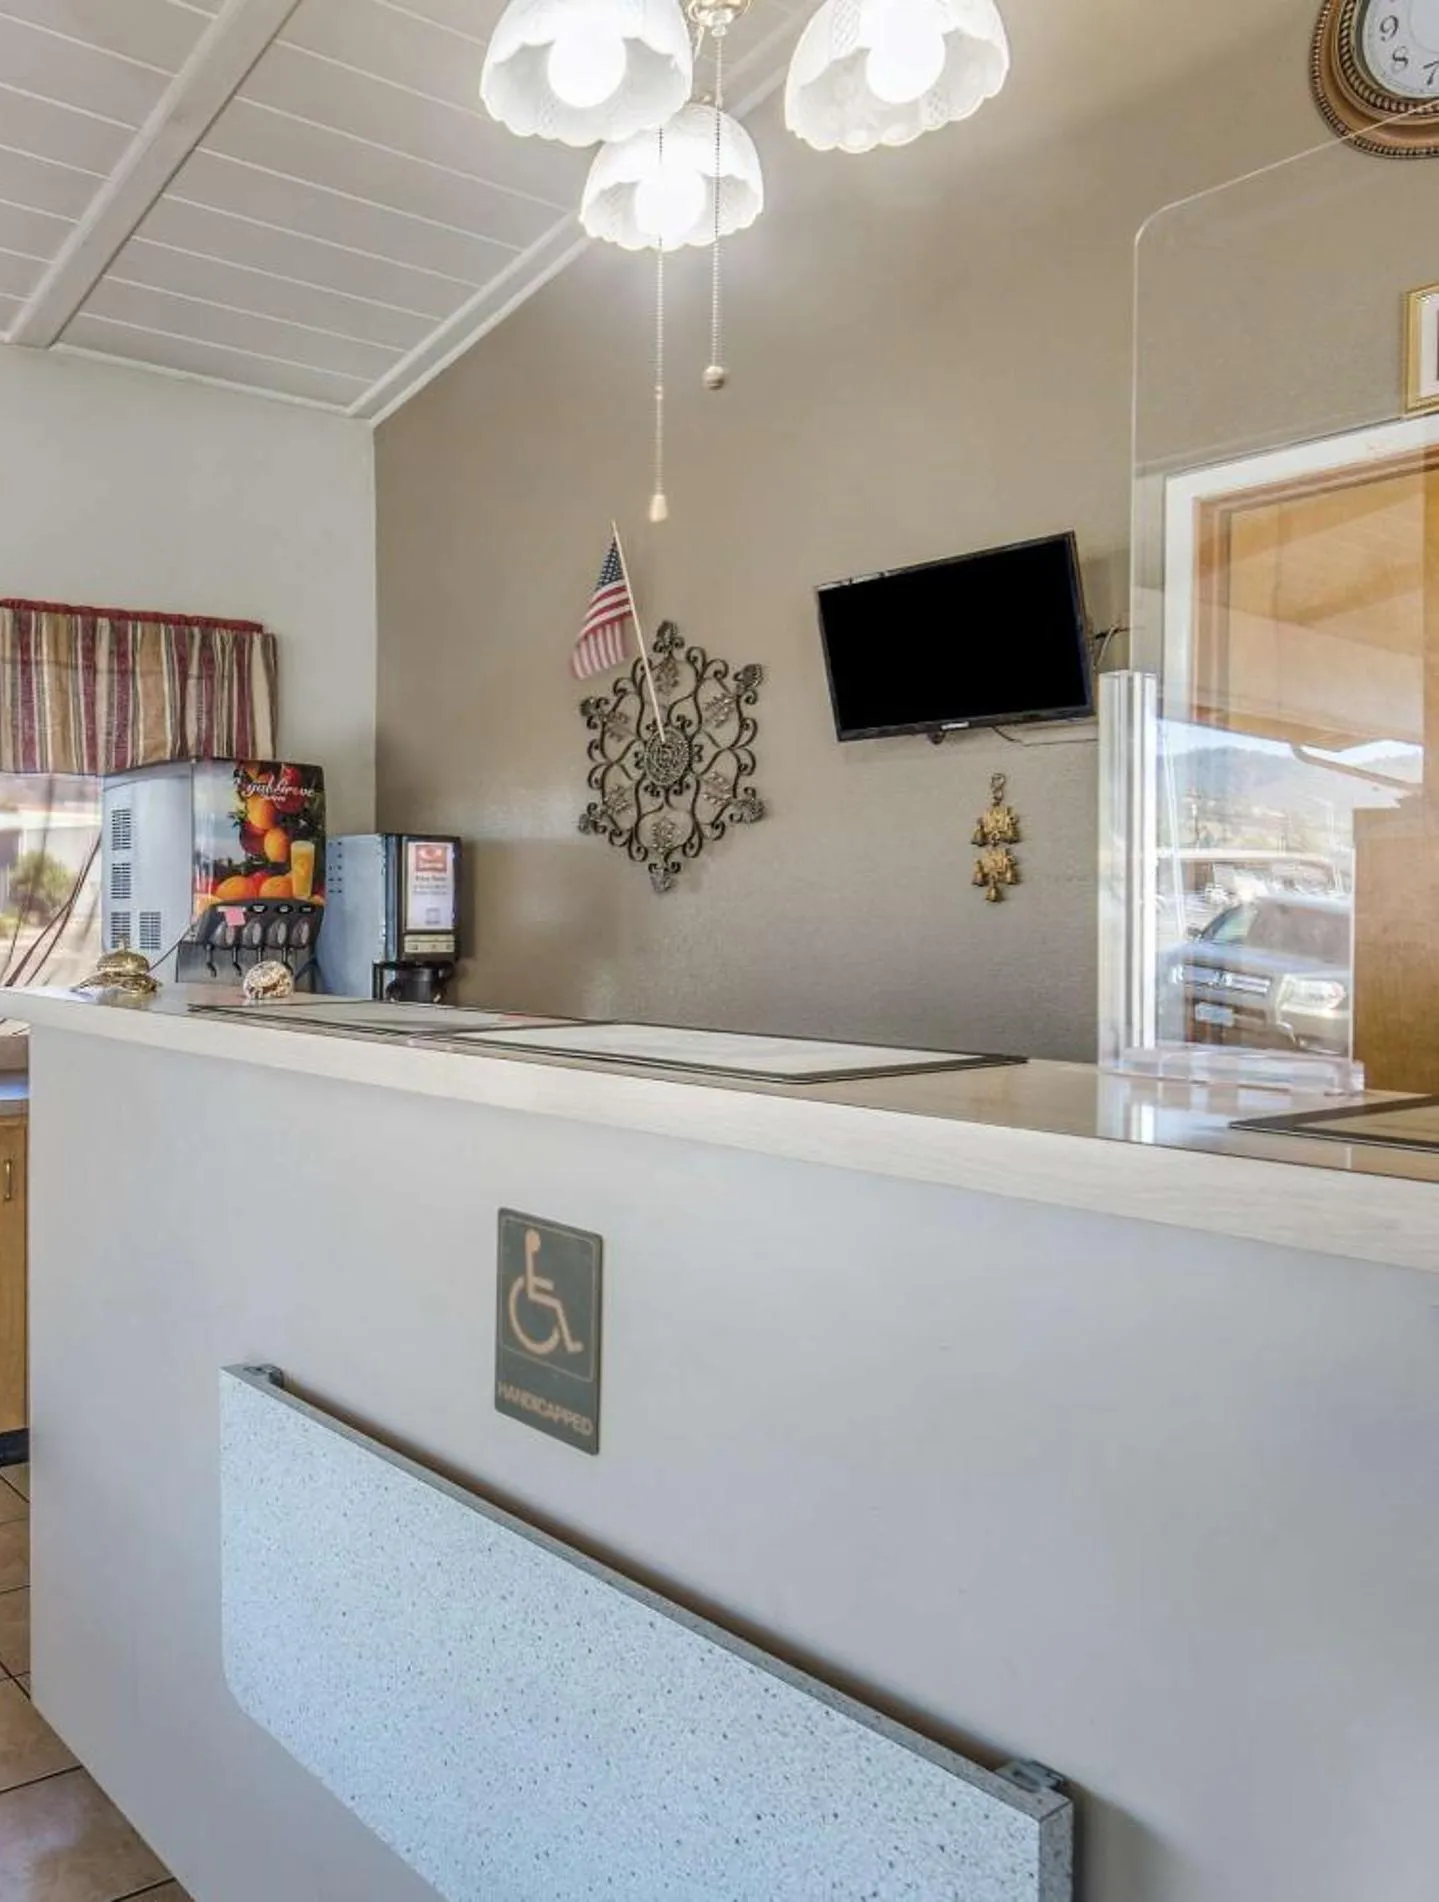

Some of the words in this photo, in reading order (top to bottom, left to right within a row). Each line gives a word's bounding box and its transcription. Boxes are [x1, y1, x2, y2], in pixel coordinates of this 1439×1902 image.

[1380, 15, 1399, 42] 9
[1392, 46, 1409, 74] 8
[497, 1381, 594, 1436] HANDICAPPED
